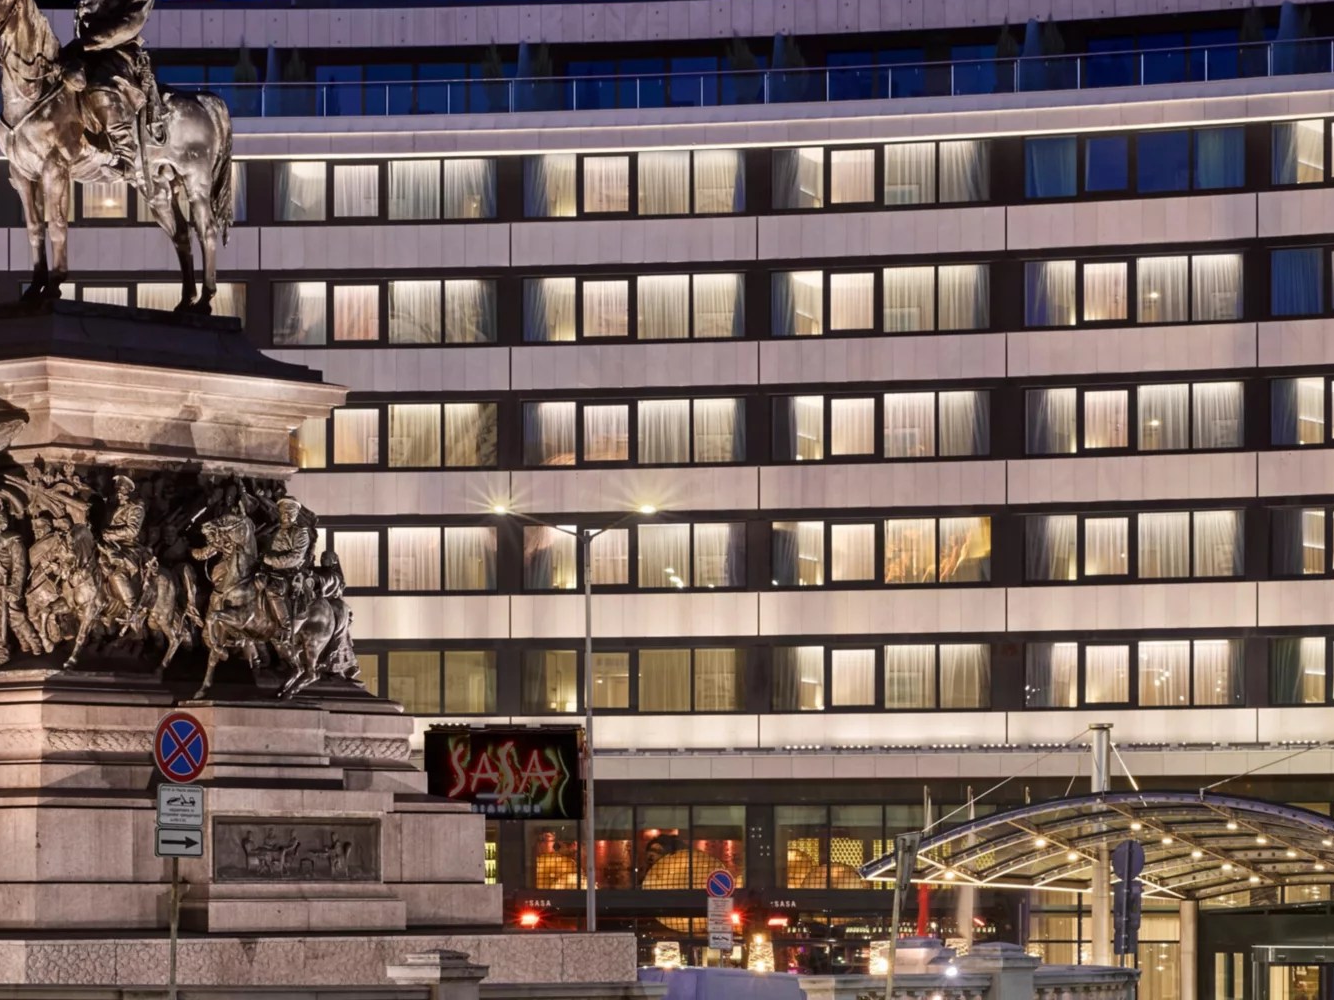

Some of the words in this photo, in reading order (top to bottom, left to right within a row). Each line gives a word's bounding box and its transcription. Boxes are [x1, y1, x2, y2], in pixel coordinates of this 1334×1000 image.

[448, 741, 556, 804] SASA
[471, 804, 507, 813] SIAN
[774, 900, 797, 908] SASA
